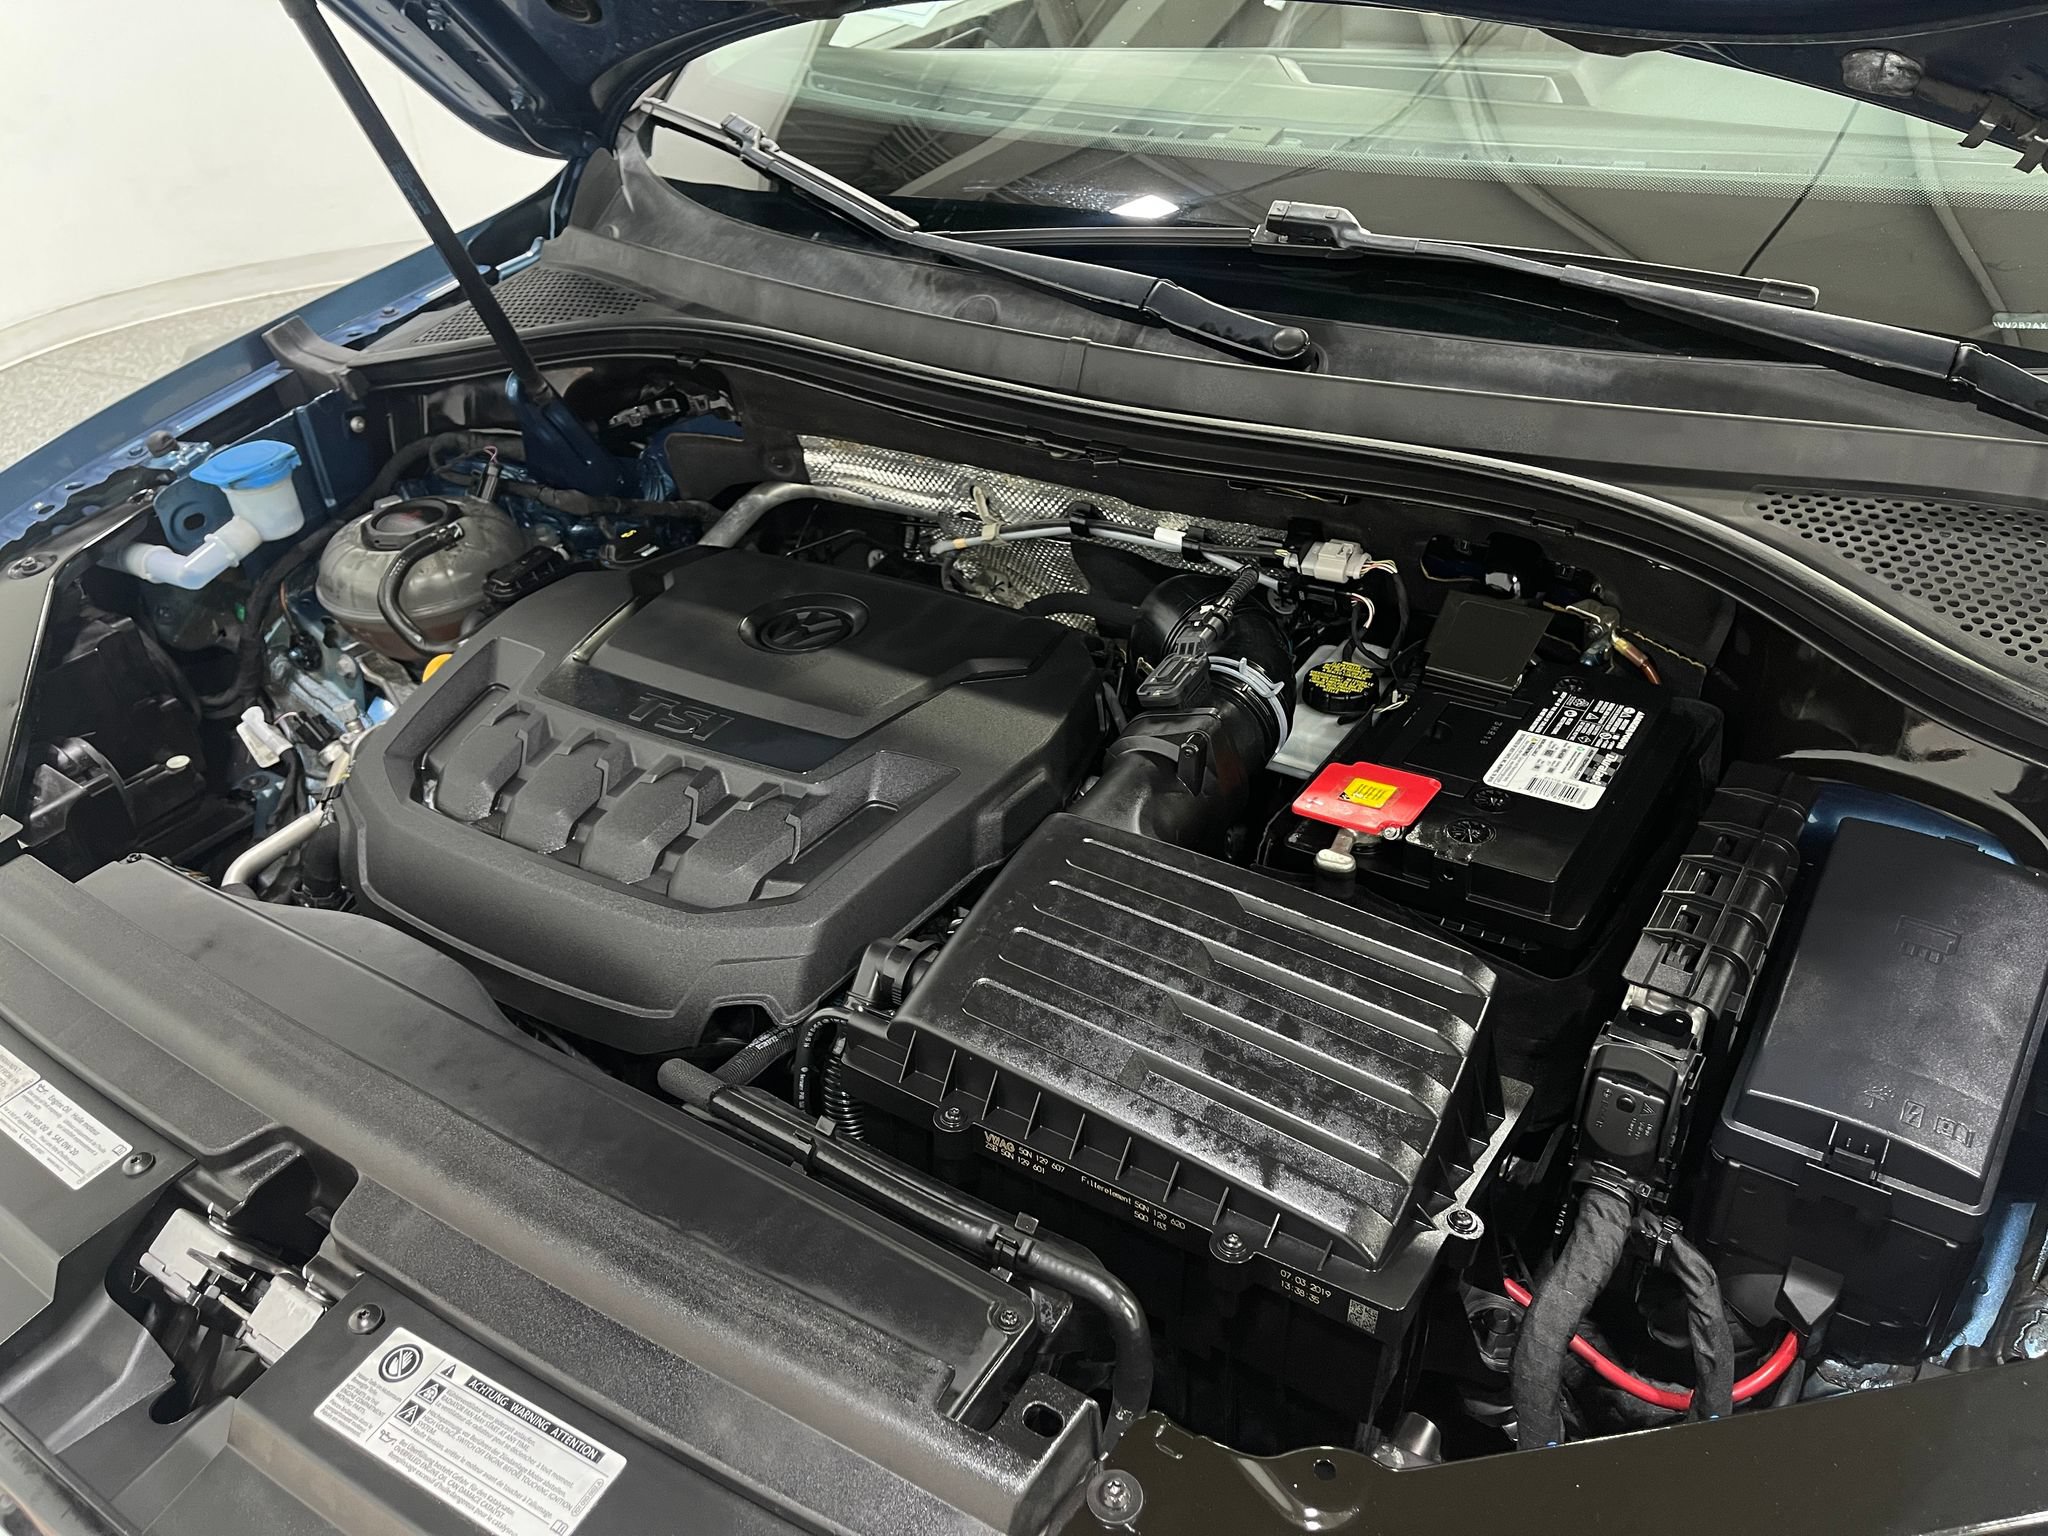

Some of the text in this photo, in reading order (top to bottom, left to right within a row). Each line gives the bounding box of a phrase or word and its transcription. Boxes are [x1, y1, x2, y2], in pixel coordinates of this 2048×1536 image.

[628, 692, 735, 741] TSI
[1589, 751, 1619, 785] Duralast
[22, 1111, 33, 1119] VW
[52, 1135, 63, 1143] SAE
[984, 1130, 1015, 1153] VWAG
[1036, 1155, 1048, 1165] 129
[1051, 1162, 1065, 1173] 607
[1018, 1156, 1030, 1166] 129
[1032, 1164, 1045, 1174] 601
[1081, 1175, 1132, 1205] Filterelement
[1153, 1209, 1167, 1220] 129
[1170, 1218, 1185, 1230] 620
[462, 1408, 475, 1417] FAN
[472, 1414, 486, 1424] MAY
[483, 1420, 500, 1432] START
[496, 1428, 507, 1437] AT
[468, 1378, 598, 1459] ACHTUNG WARNING ATTENTION
[421, 1413, 437, 1425] HIGH
[455, 1434, 477, 1450] SWITCH
[473, 1446, 486, 1456] OFF
[483, 1452, 505, 1467] ENGINE
[519, 1474, 550, 1496] TOUCHING
[546, 1491, 574, 1510] IGNITION
[457, 1485, 482, 1504] DAMAGE
